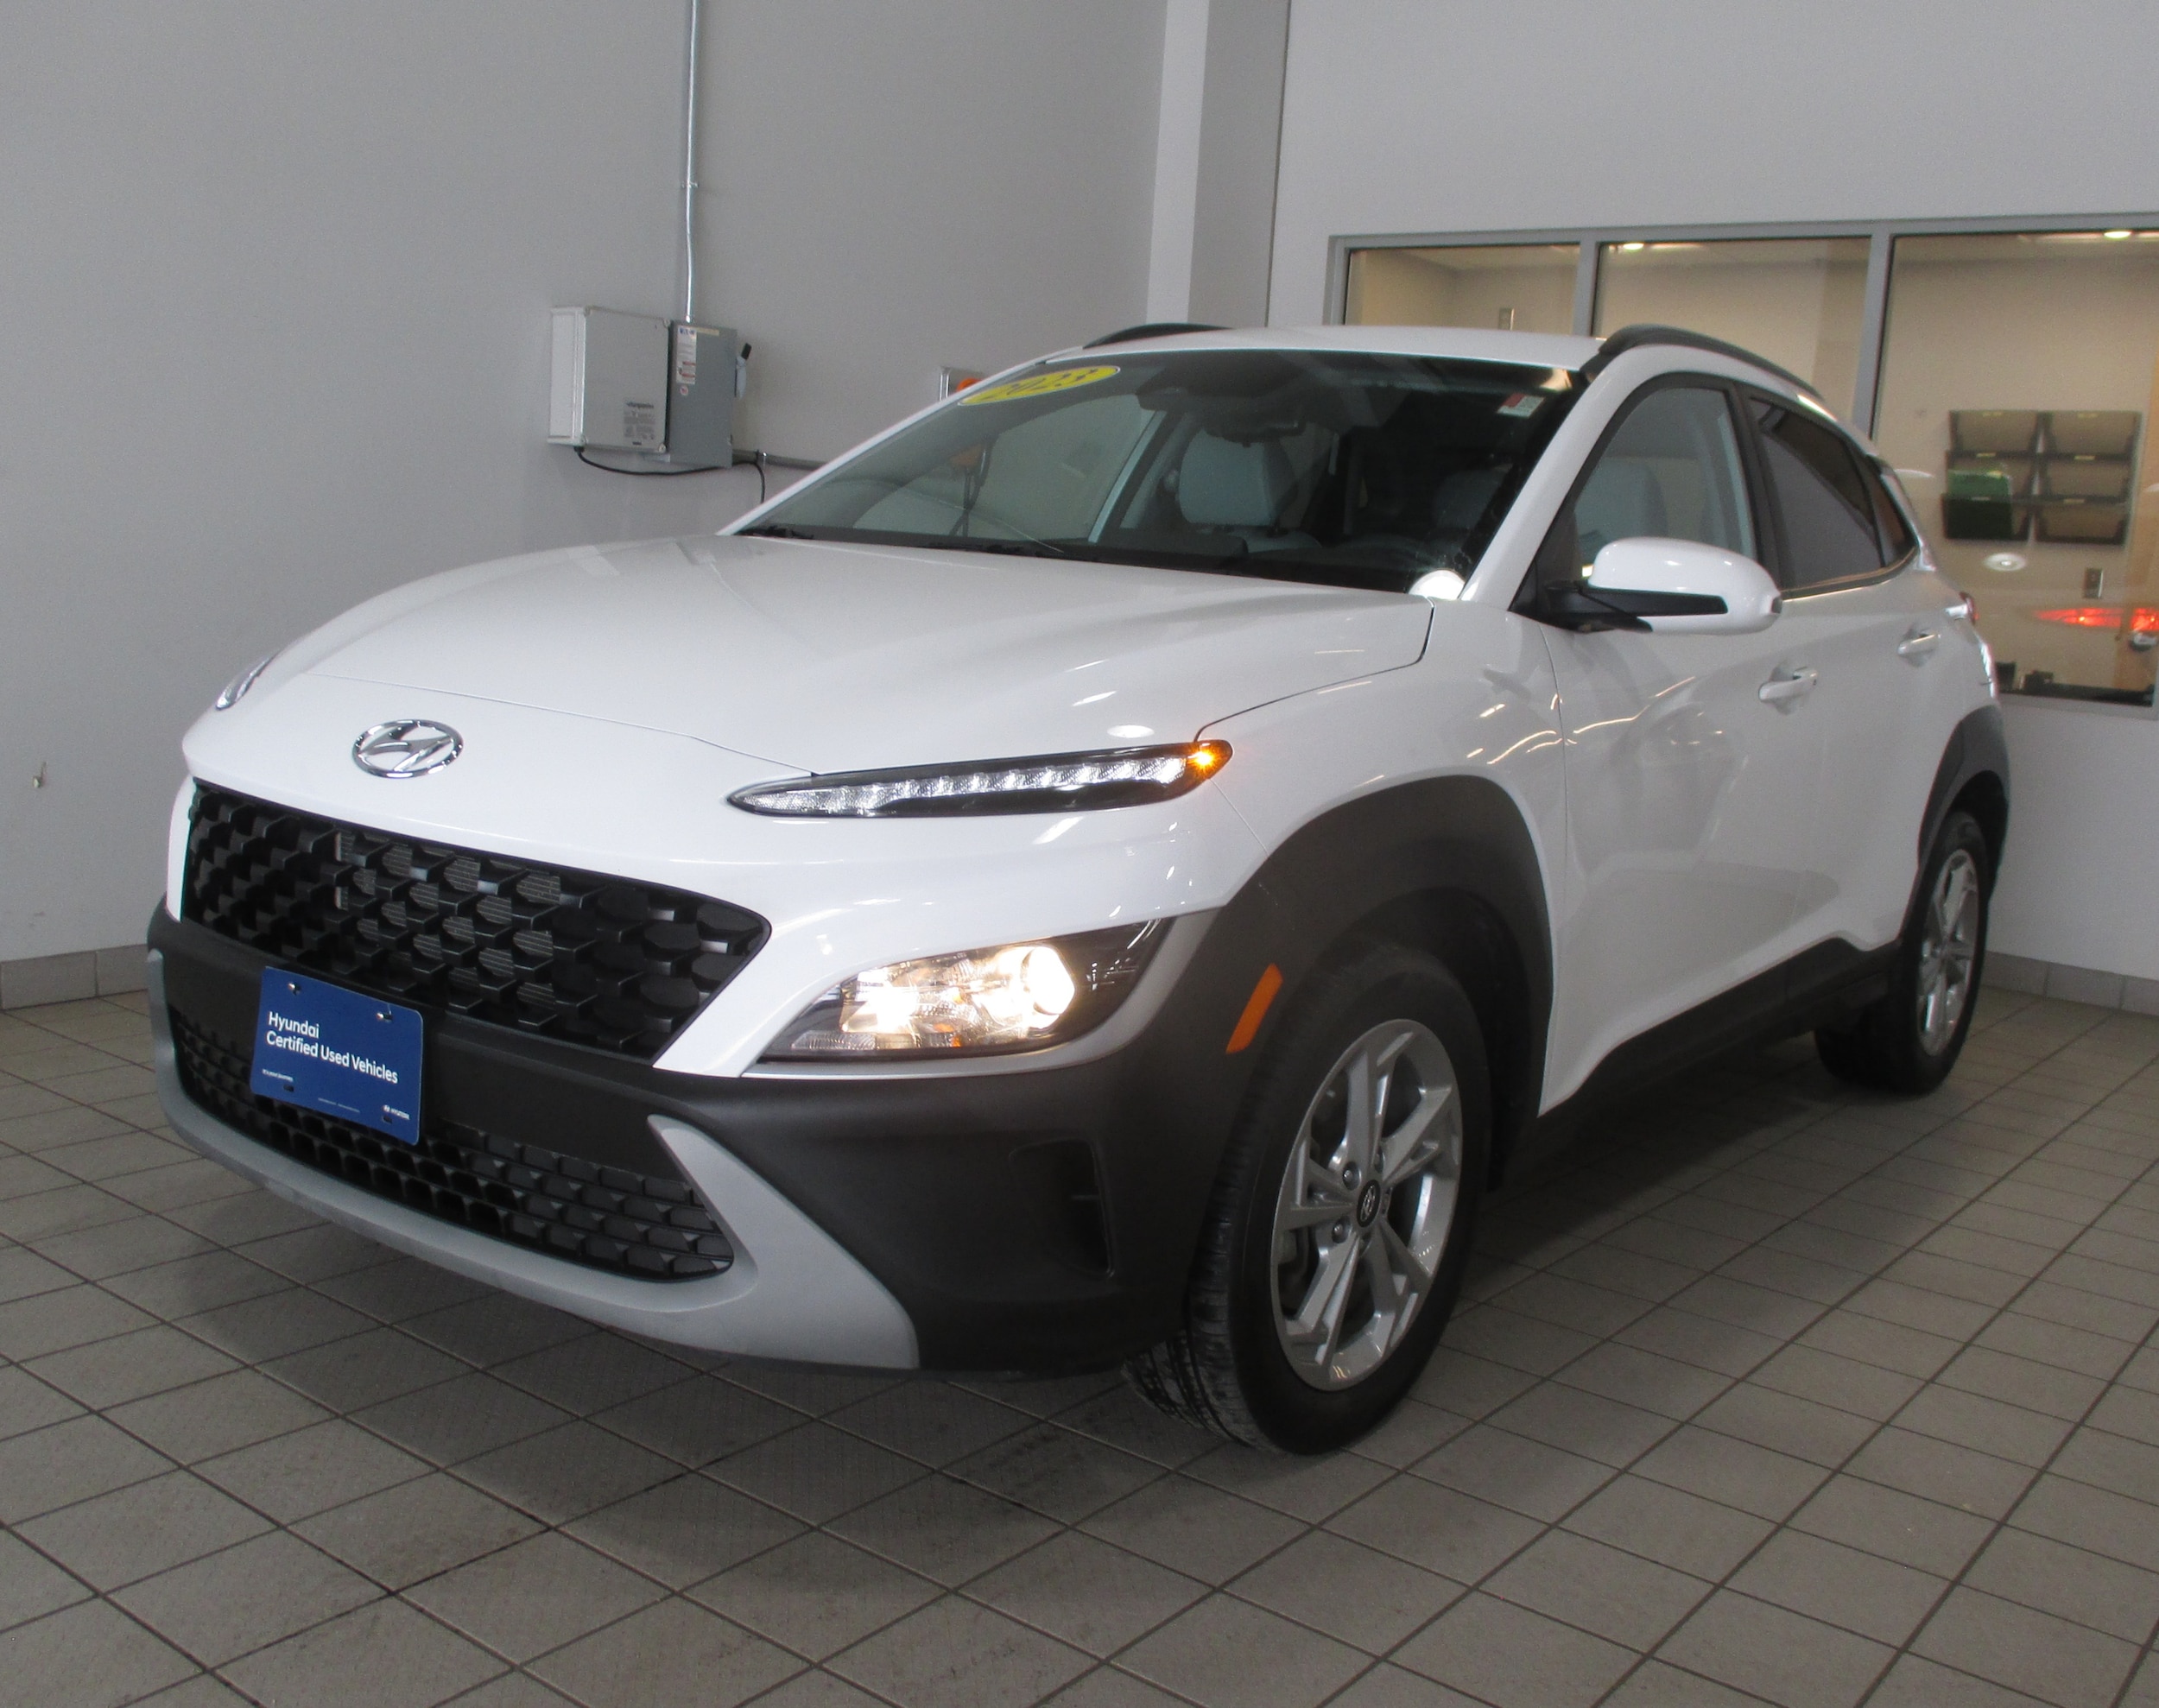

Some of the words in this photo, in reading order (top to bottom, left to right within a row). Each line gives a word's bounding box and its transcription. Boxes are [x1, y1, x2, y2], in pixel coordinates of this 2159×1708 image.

[268, 1011, 320, 1039] Hyundai
[266, 1030, 319, 1058] Certified
[320, 1044, 350, 1067] Used
[351, 1054, 398, 1084] Vehicles
